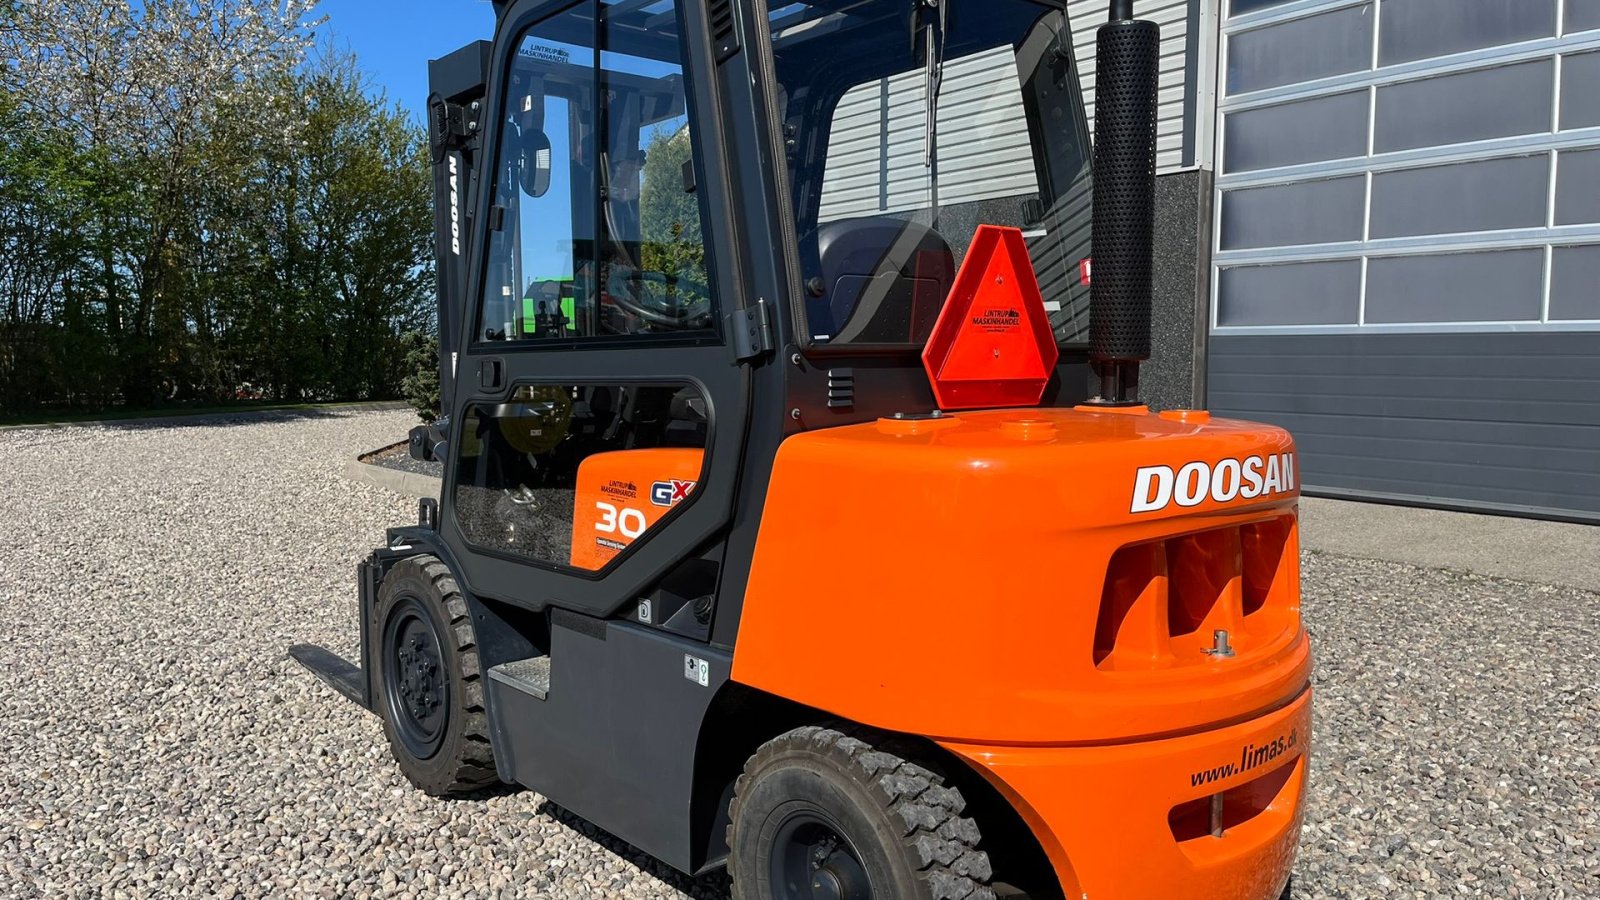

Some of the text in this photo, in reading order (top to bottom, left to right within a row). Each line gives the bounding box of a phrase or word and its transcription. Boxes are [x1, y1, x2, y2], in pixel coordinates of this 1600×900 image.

[520, 49, 569, 63] MASKINHANDEL
[530, 44, 558, 54] LINTRUP
[449, 155, 460, 256] DOOSAN
[984, 310, 1009, 318] LINTRUP
[973, 317, 1020, 326] MASKINHANDEL
[609, 480, 629, 489] LINTRUP
[1130, 452, 1295, 514] DOOSAN
[601, 485, 637, 498] MASKINHANDEL
[650, 479, 696, 506] GX
[595, 501, 647, 539] 30
[1191, 728, 1298, 787] www.limas.dk
